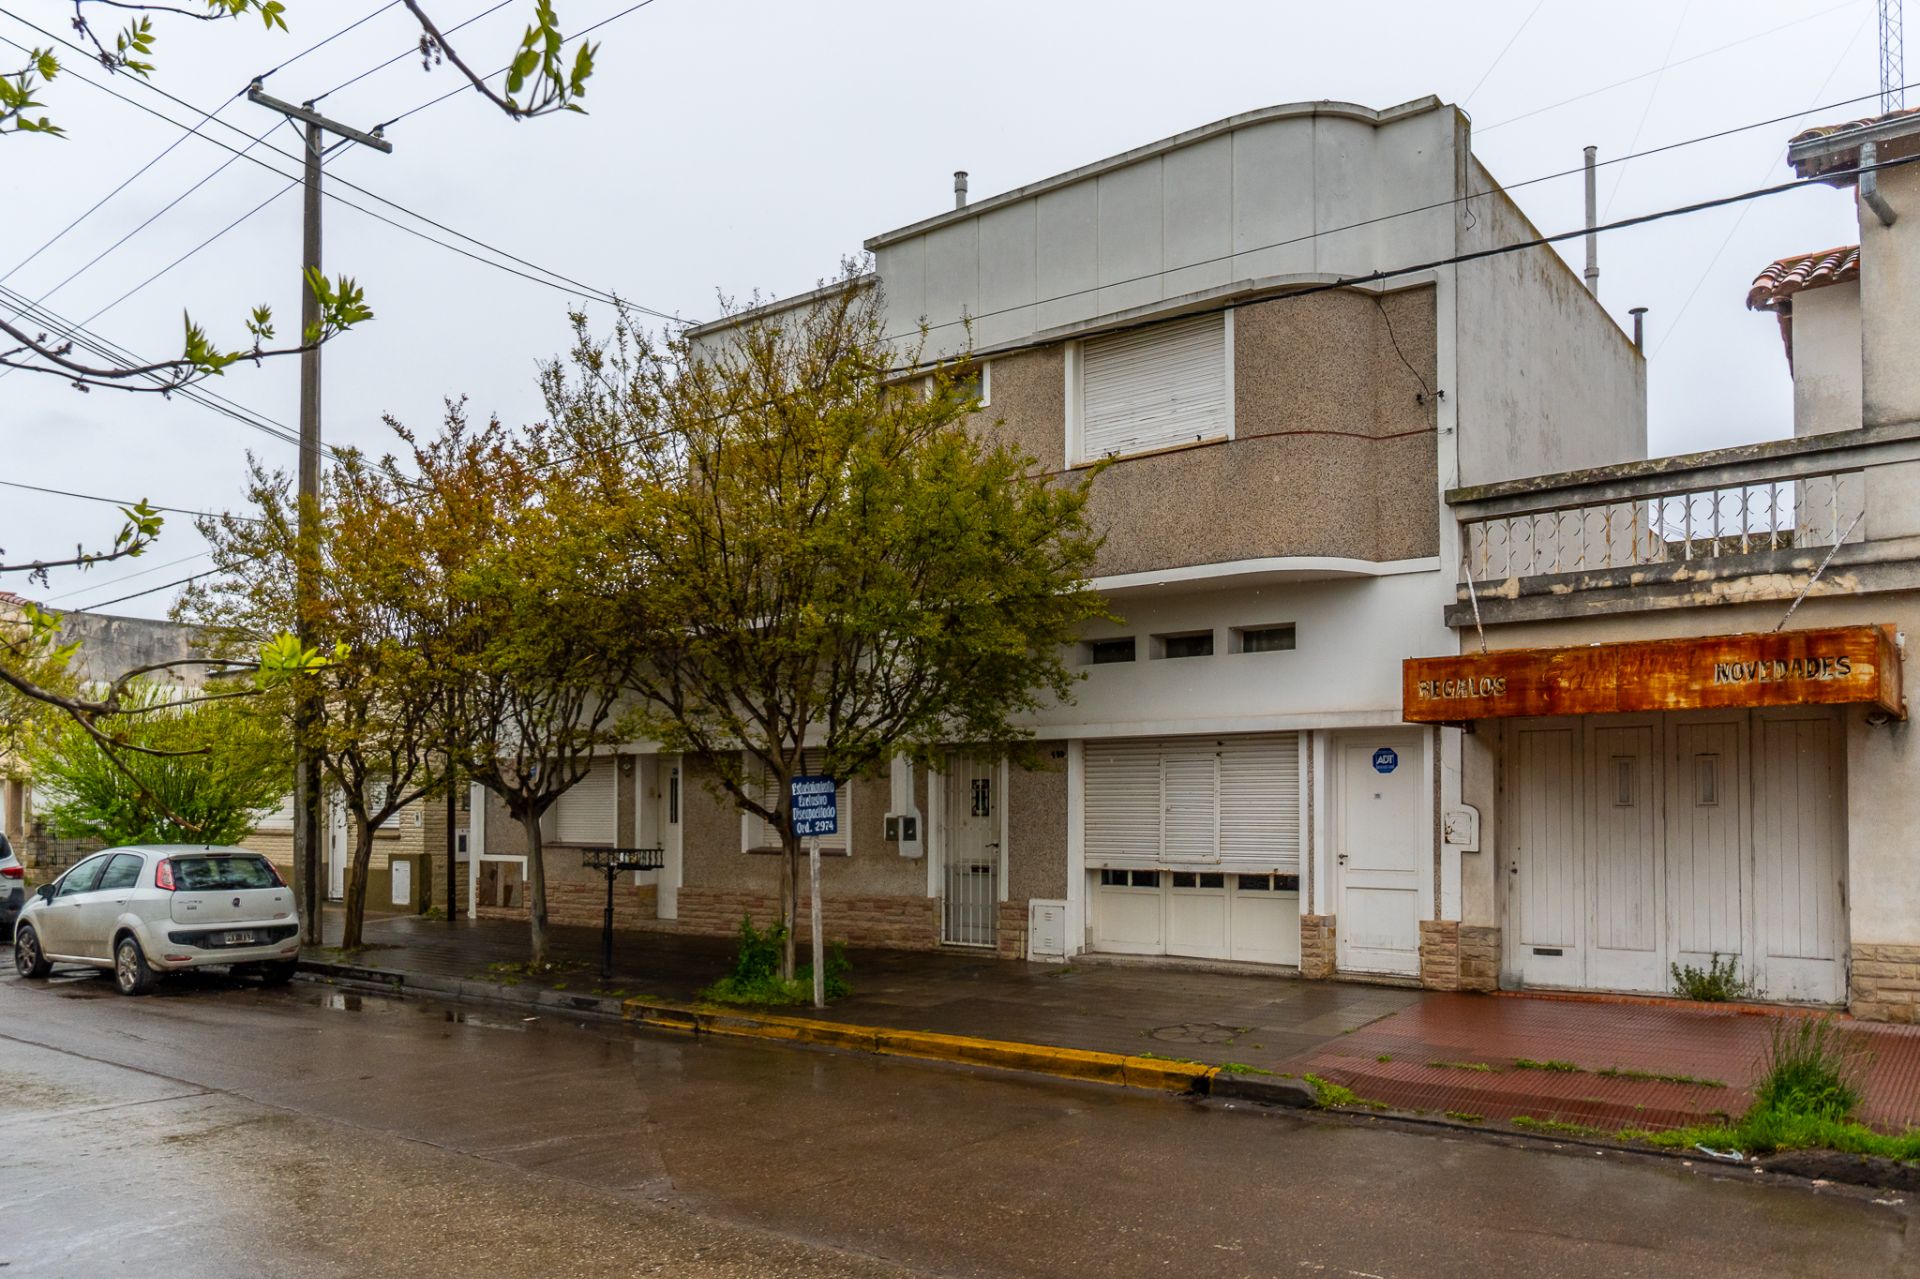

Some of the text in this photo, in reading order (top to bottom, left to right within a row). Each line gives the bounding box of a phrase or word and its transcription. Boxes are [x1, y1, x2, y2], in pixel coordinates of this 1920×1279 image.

[1714, 655, 1851, 686] NOVEDADES
[1418, 676, 1507, 700] REGALOS
[1376, 755, 1394, 764] ADT
[799, 795, 828, 807] Exclusivo
[796, 820, 834, 834] Ord. 2974
